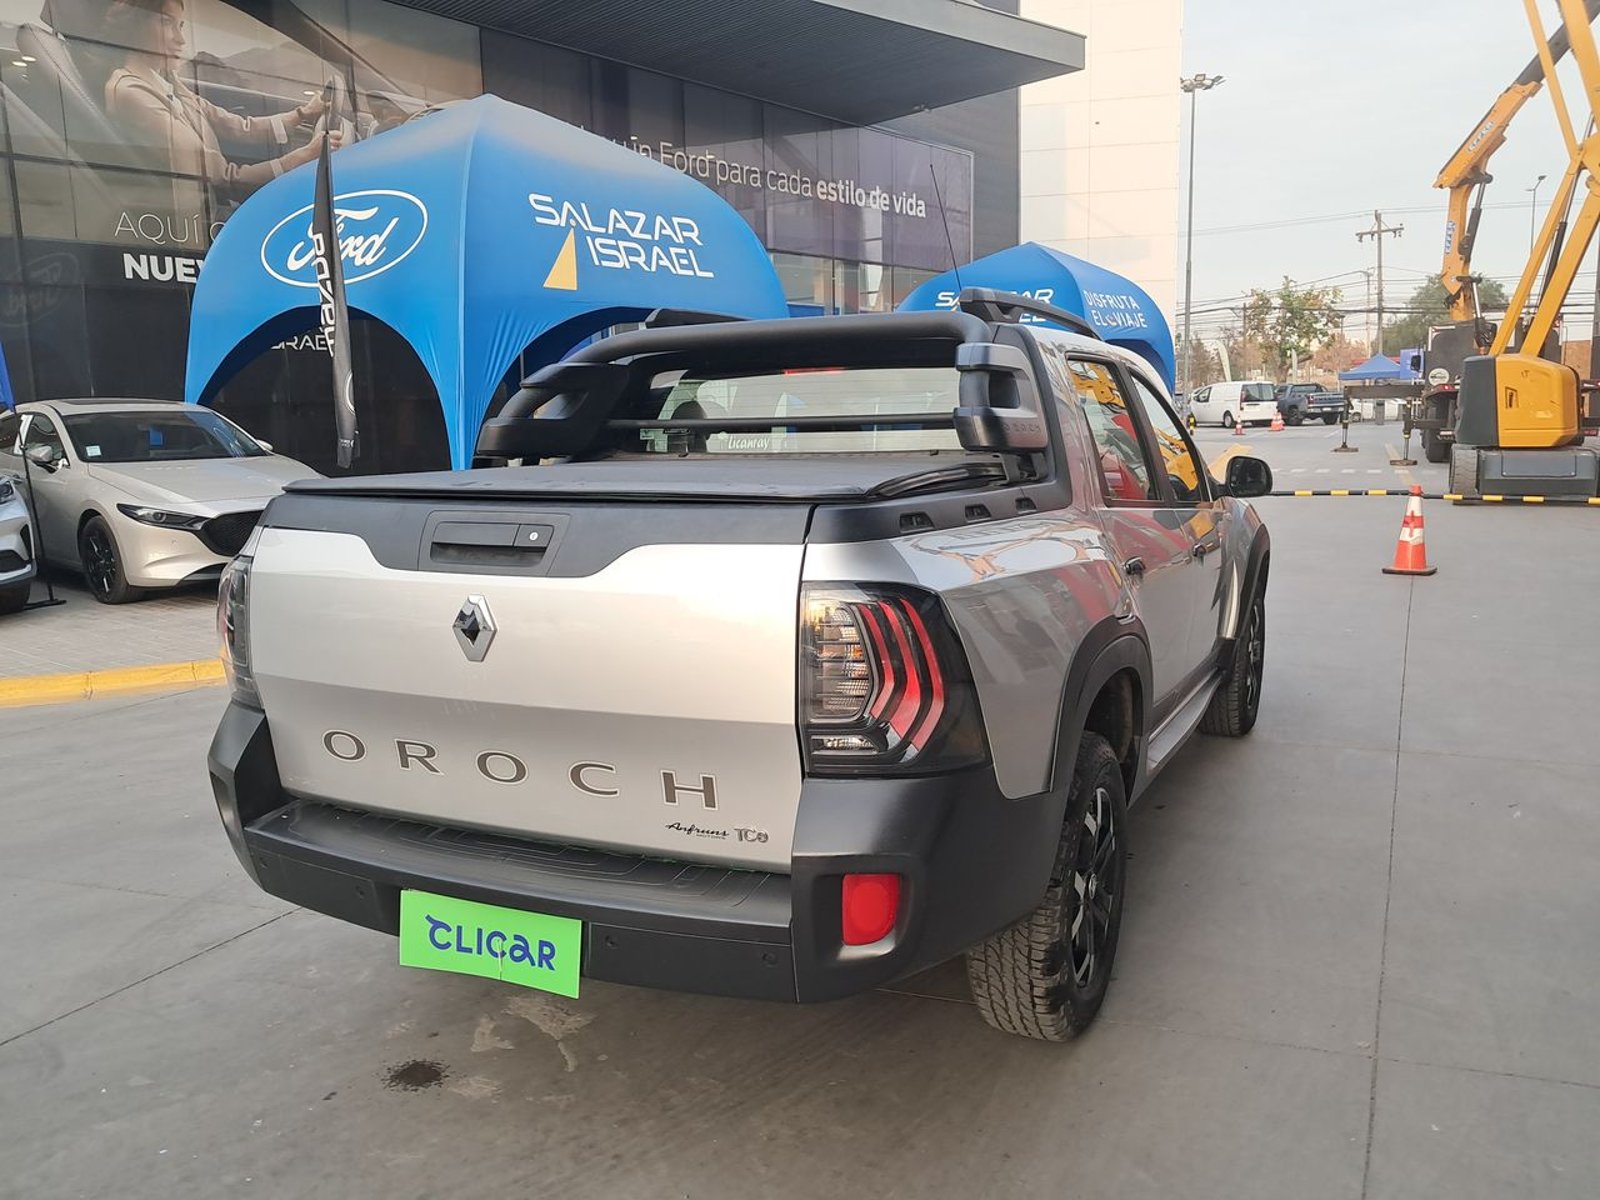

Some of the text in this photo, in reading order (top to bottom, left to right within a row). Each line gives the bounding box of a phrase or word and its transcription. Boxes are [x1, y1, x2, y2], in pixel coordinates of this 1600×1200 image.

[660, 141, 709, 178] Ford
[715, 160, 761, 188] para
[766, 169, 813, 197] cada
[817, 180, 866, 207] estilo
[869, 185, 890, 211] de
[892, 192, 927, 218] vida
[114, 211, 201, 245] AQUÍ
[528, 193, 704, 246] SALAZAR
[585, 235, 715, 278] ISRAEL
[1083, 290, 1141, 310] DISFRUTA
[1112, 311, 1148, 328] VIAJE
[321, 729, 719, 811] OROCH
